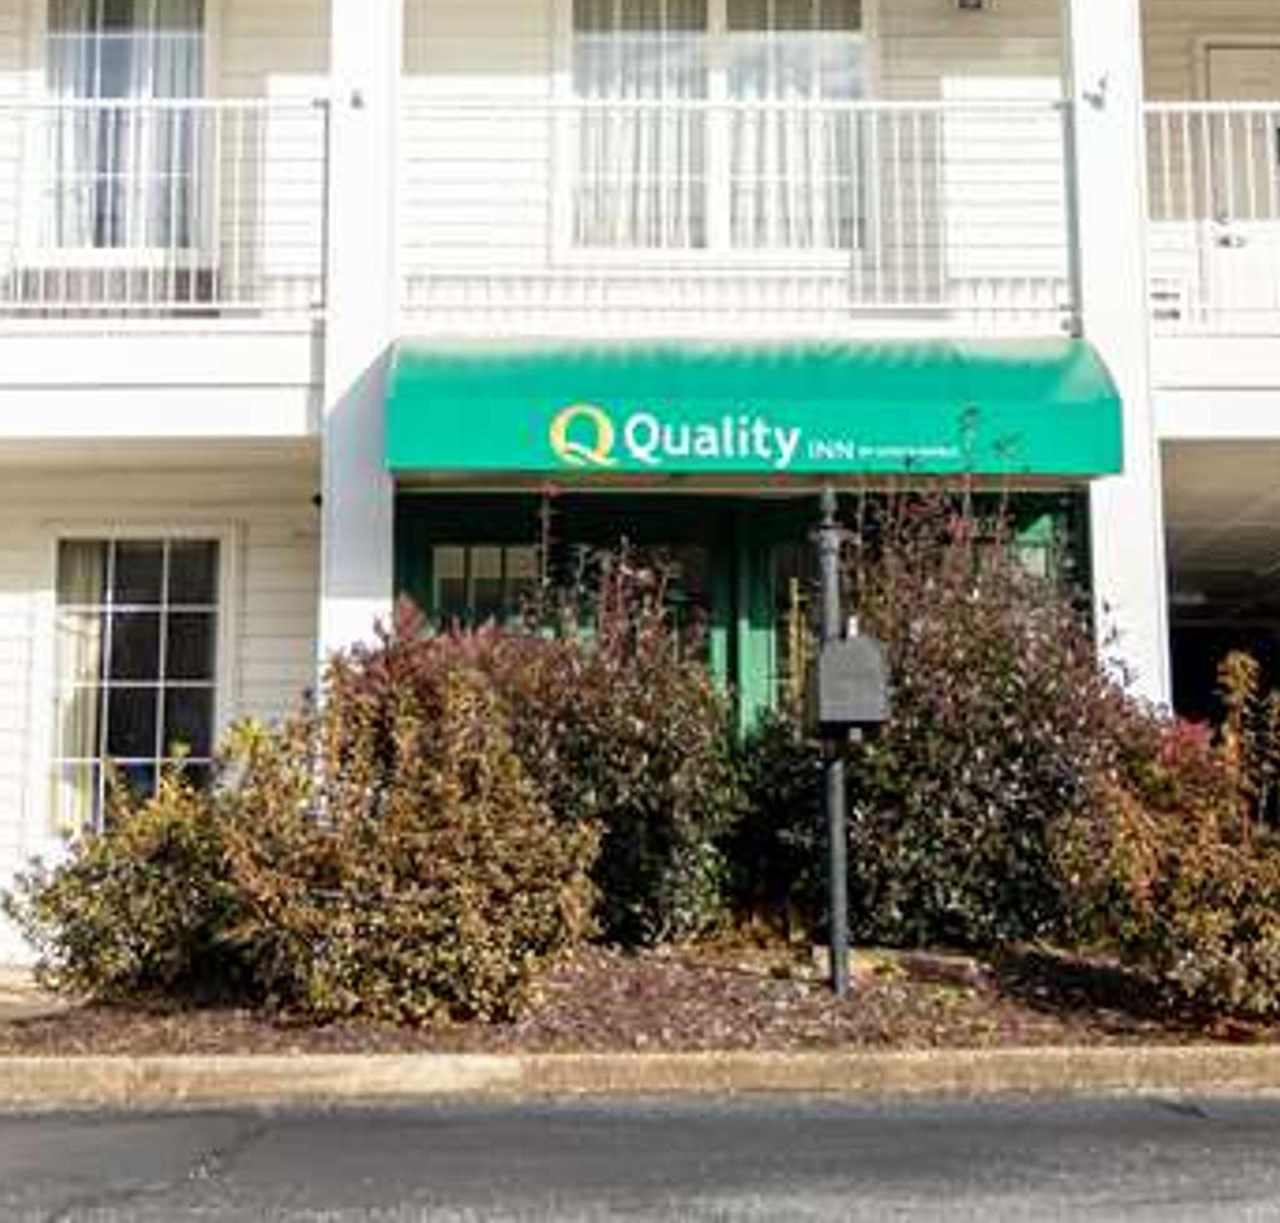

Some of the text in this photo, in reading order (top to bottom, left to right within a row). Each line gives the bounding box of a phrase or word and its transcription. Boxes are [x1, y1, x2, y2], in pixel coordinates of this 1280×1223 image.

[549, 403, 854, 469] Q Quality INN
